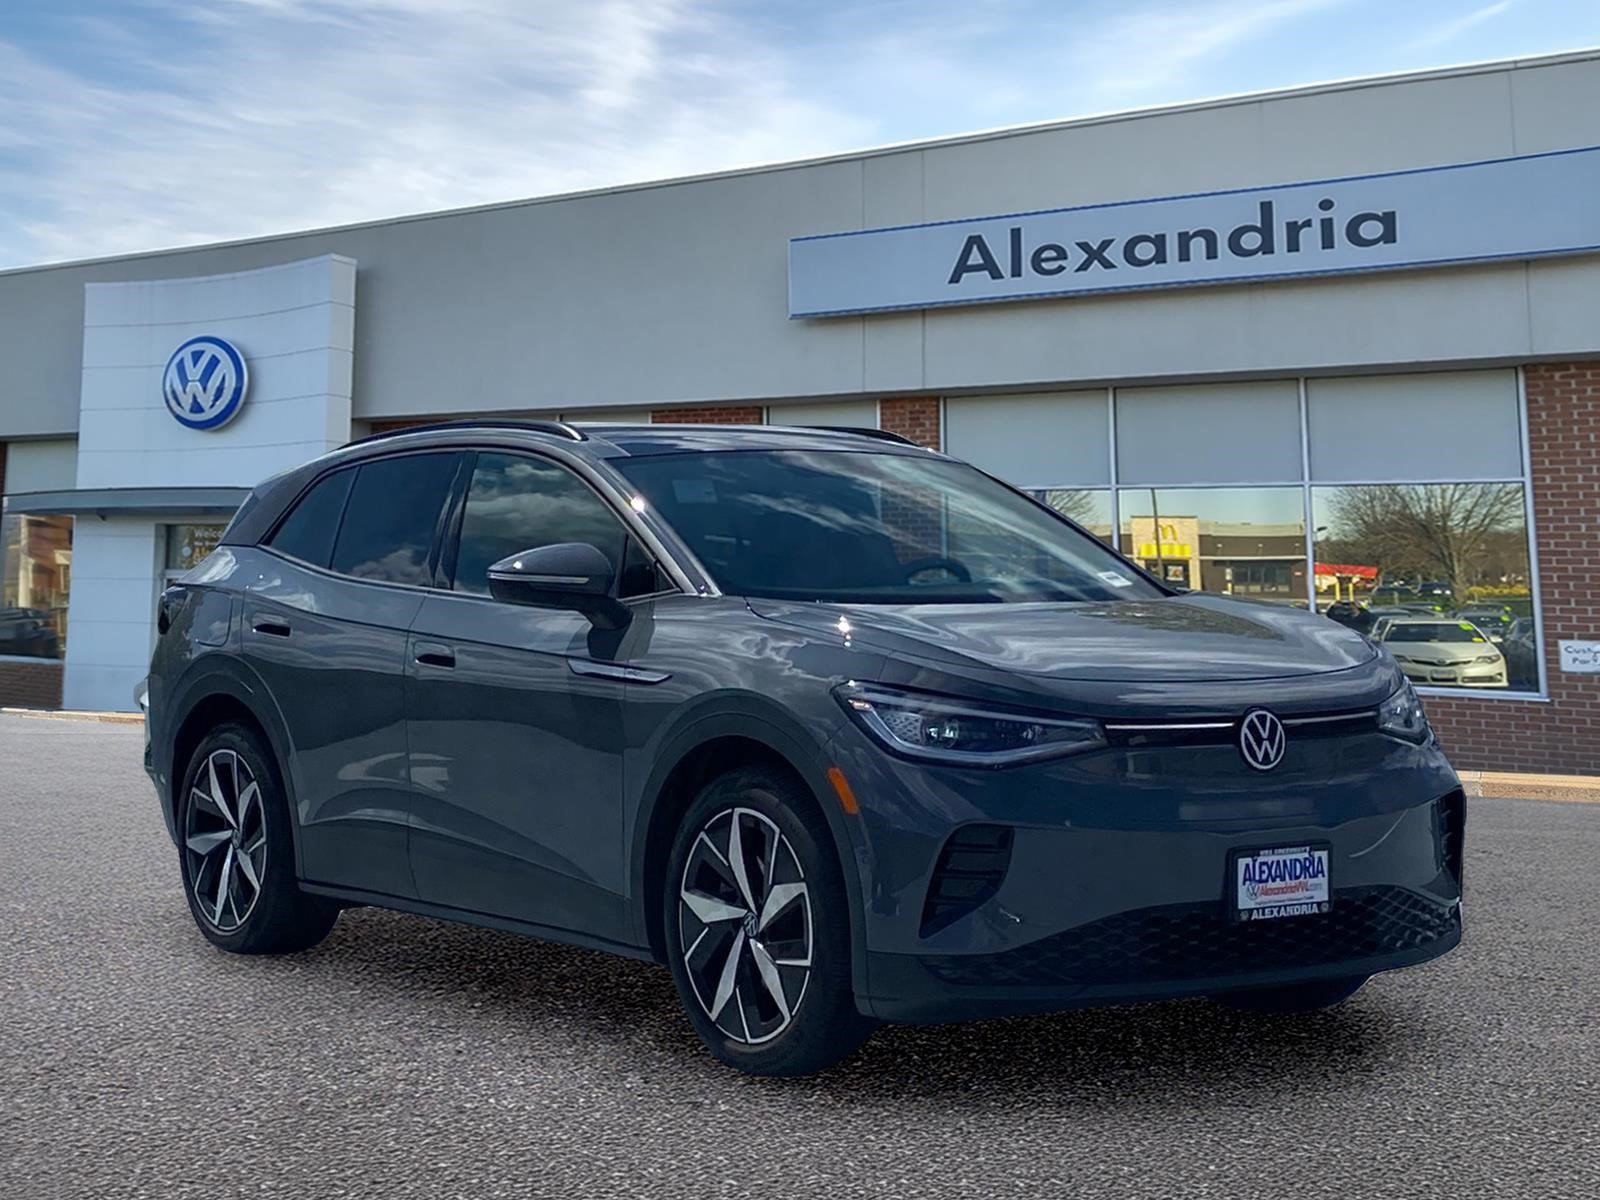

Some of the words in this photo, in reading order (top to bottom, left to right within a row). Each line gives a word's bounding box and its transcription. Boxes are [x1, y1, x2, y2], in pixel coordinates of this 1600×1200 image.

[948, 198, 1398, 284] Alexandria
[1242, 855, 1326, 886] ALEXANDRIA
[1251, 903, 1319, 920] ALEXANDRIA
